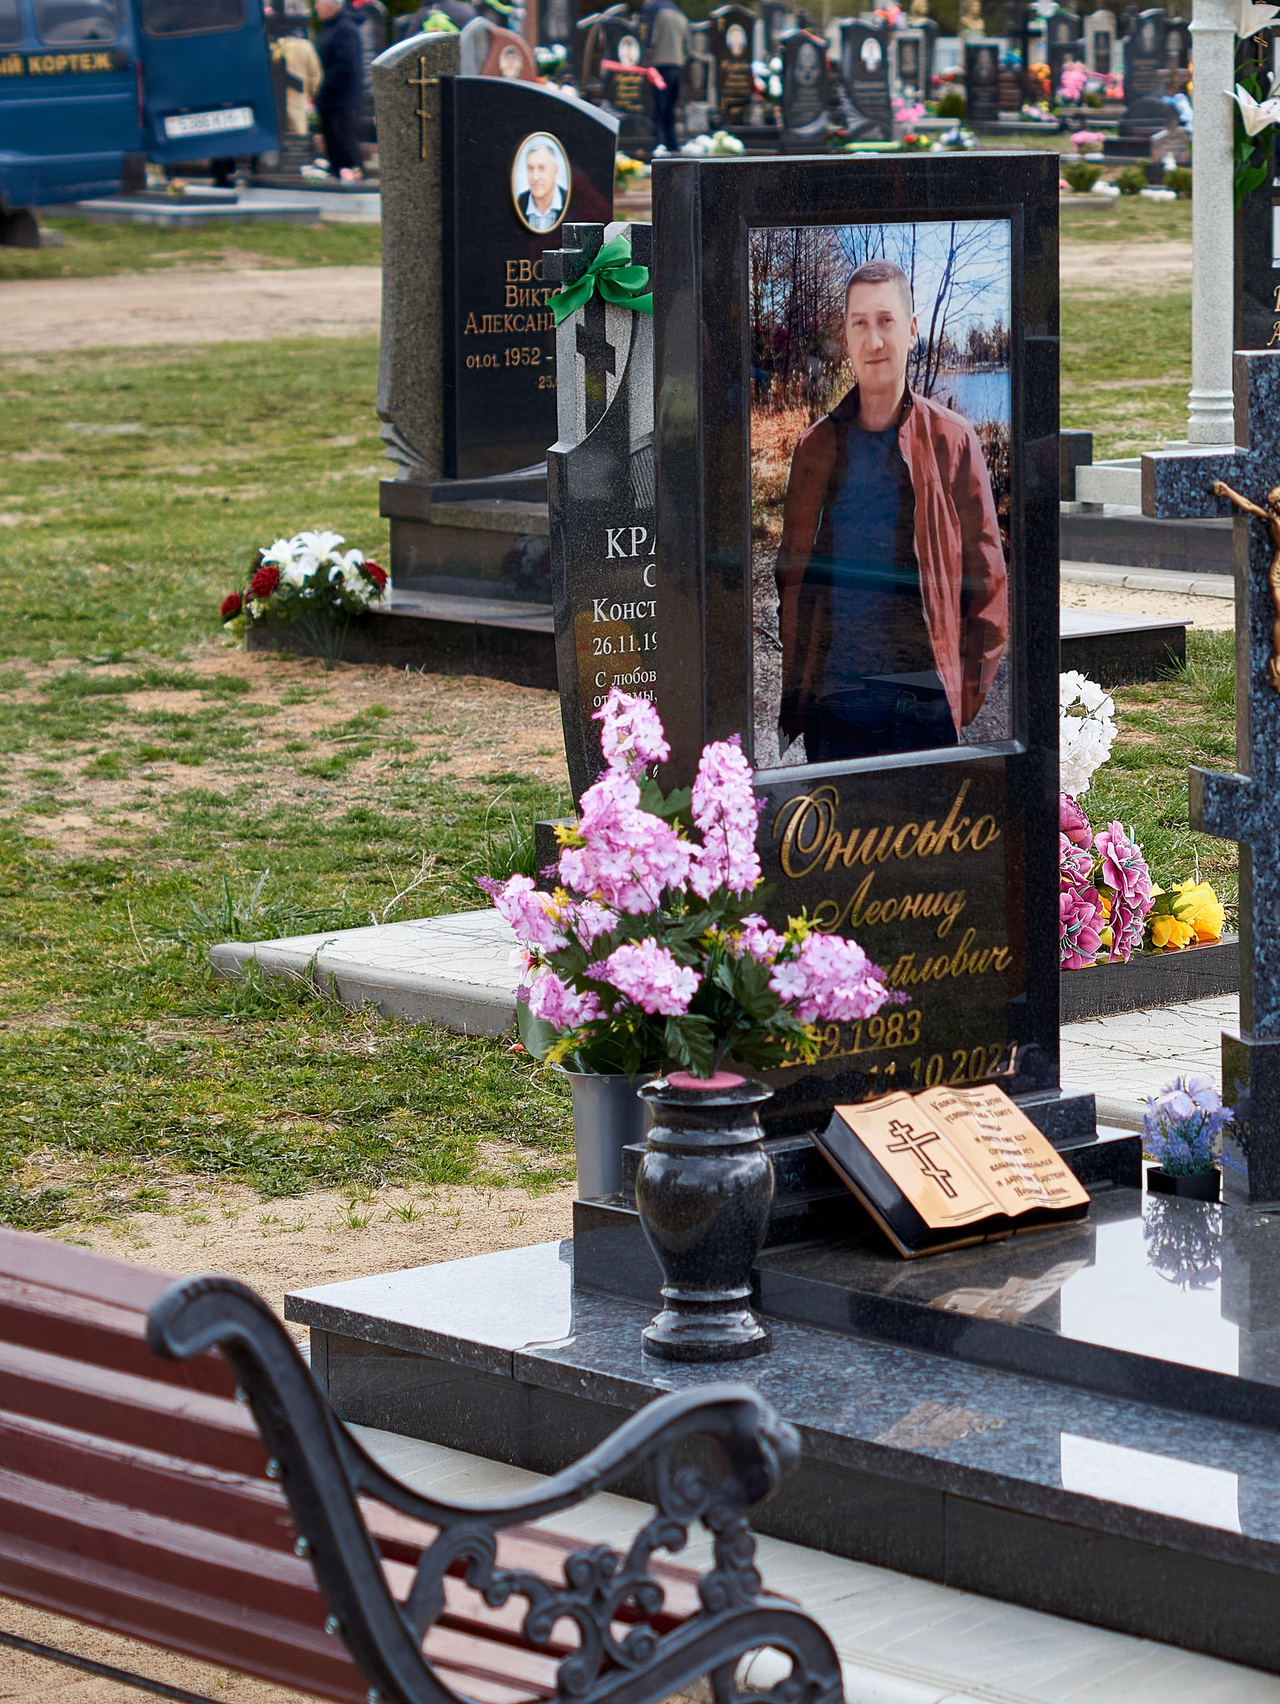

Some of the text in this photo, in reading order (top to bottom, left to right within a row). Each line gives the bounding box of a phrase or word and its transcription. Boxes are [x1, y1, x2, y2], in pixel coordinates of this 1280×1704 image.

[28, 52, 113, 74] КОРТЕЖ
[504, 347, 541, 367] 1952
[611, 666, 657, 686] любов
[772, 779, 1001, 880] Онисько
[813, 870, 968, 939] Леонид
[879, 927, 1014, 988] йлович
